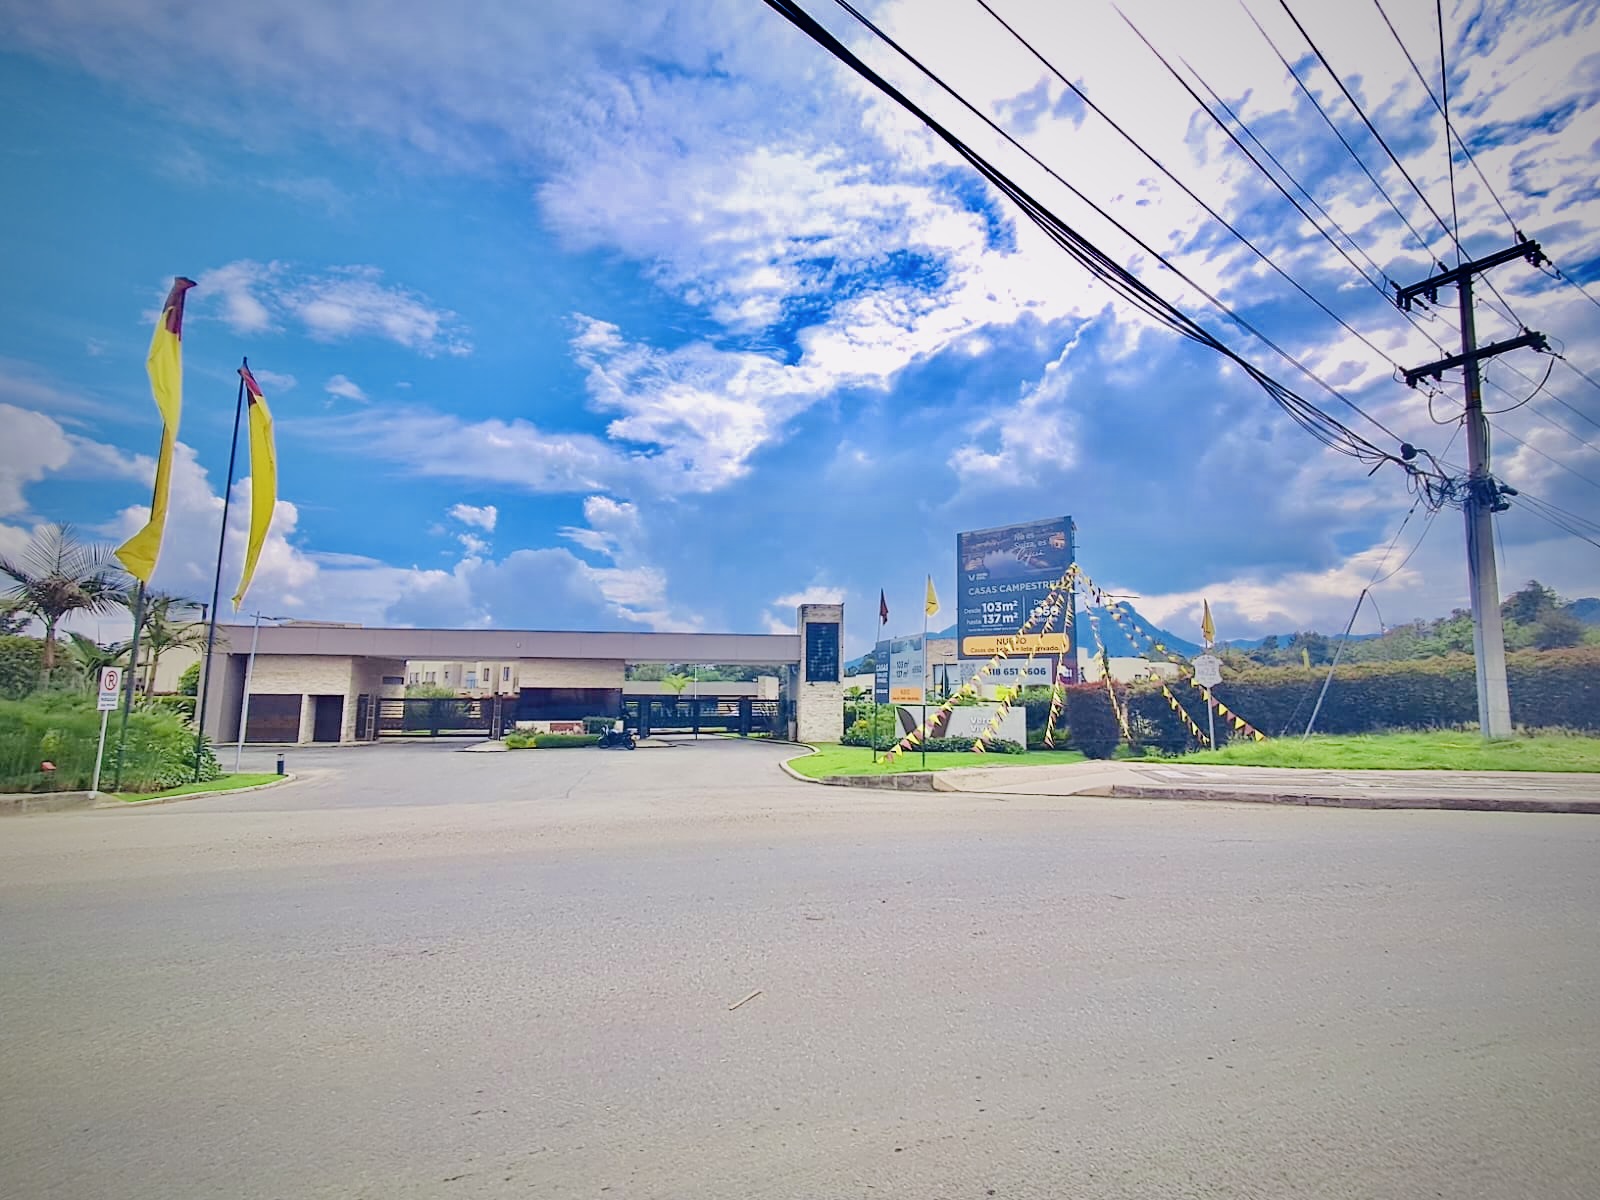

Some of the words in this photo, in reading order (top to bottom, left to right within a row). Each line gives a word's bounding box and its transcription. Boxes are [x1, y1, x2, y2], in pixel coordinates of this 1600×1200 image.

[968, 586, 998, 596] CASAS
[999, 579, 1061, 593] CAMPESTRE
[988, 668, 1001, 676] 18
[1003, 668, 1018, 676] 651
[1022, 668, 1046, 676] 606
